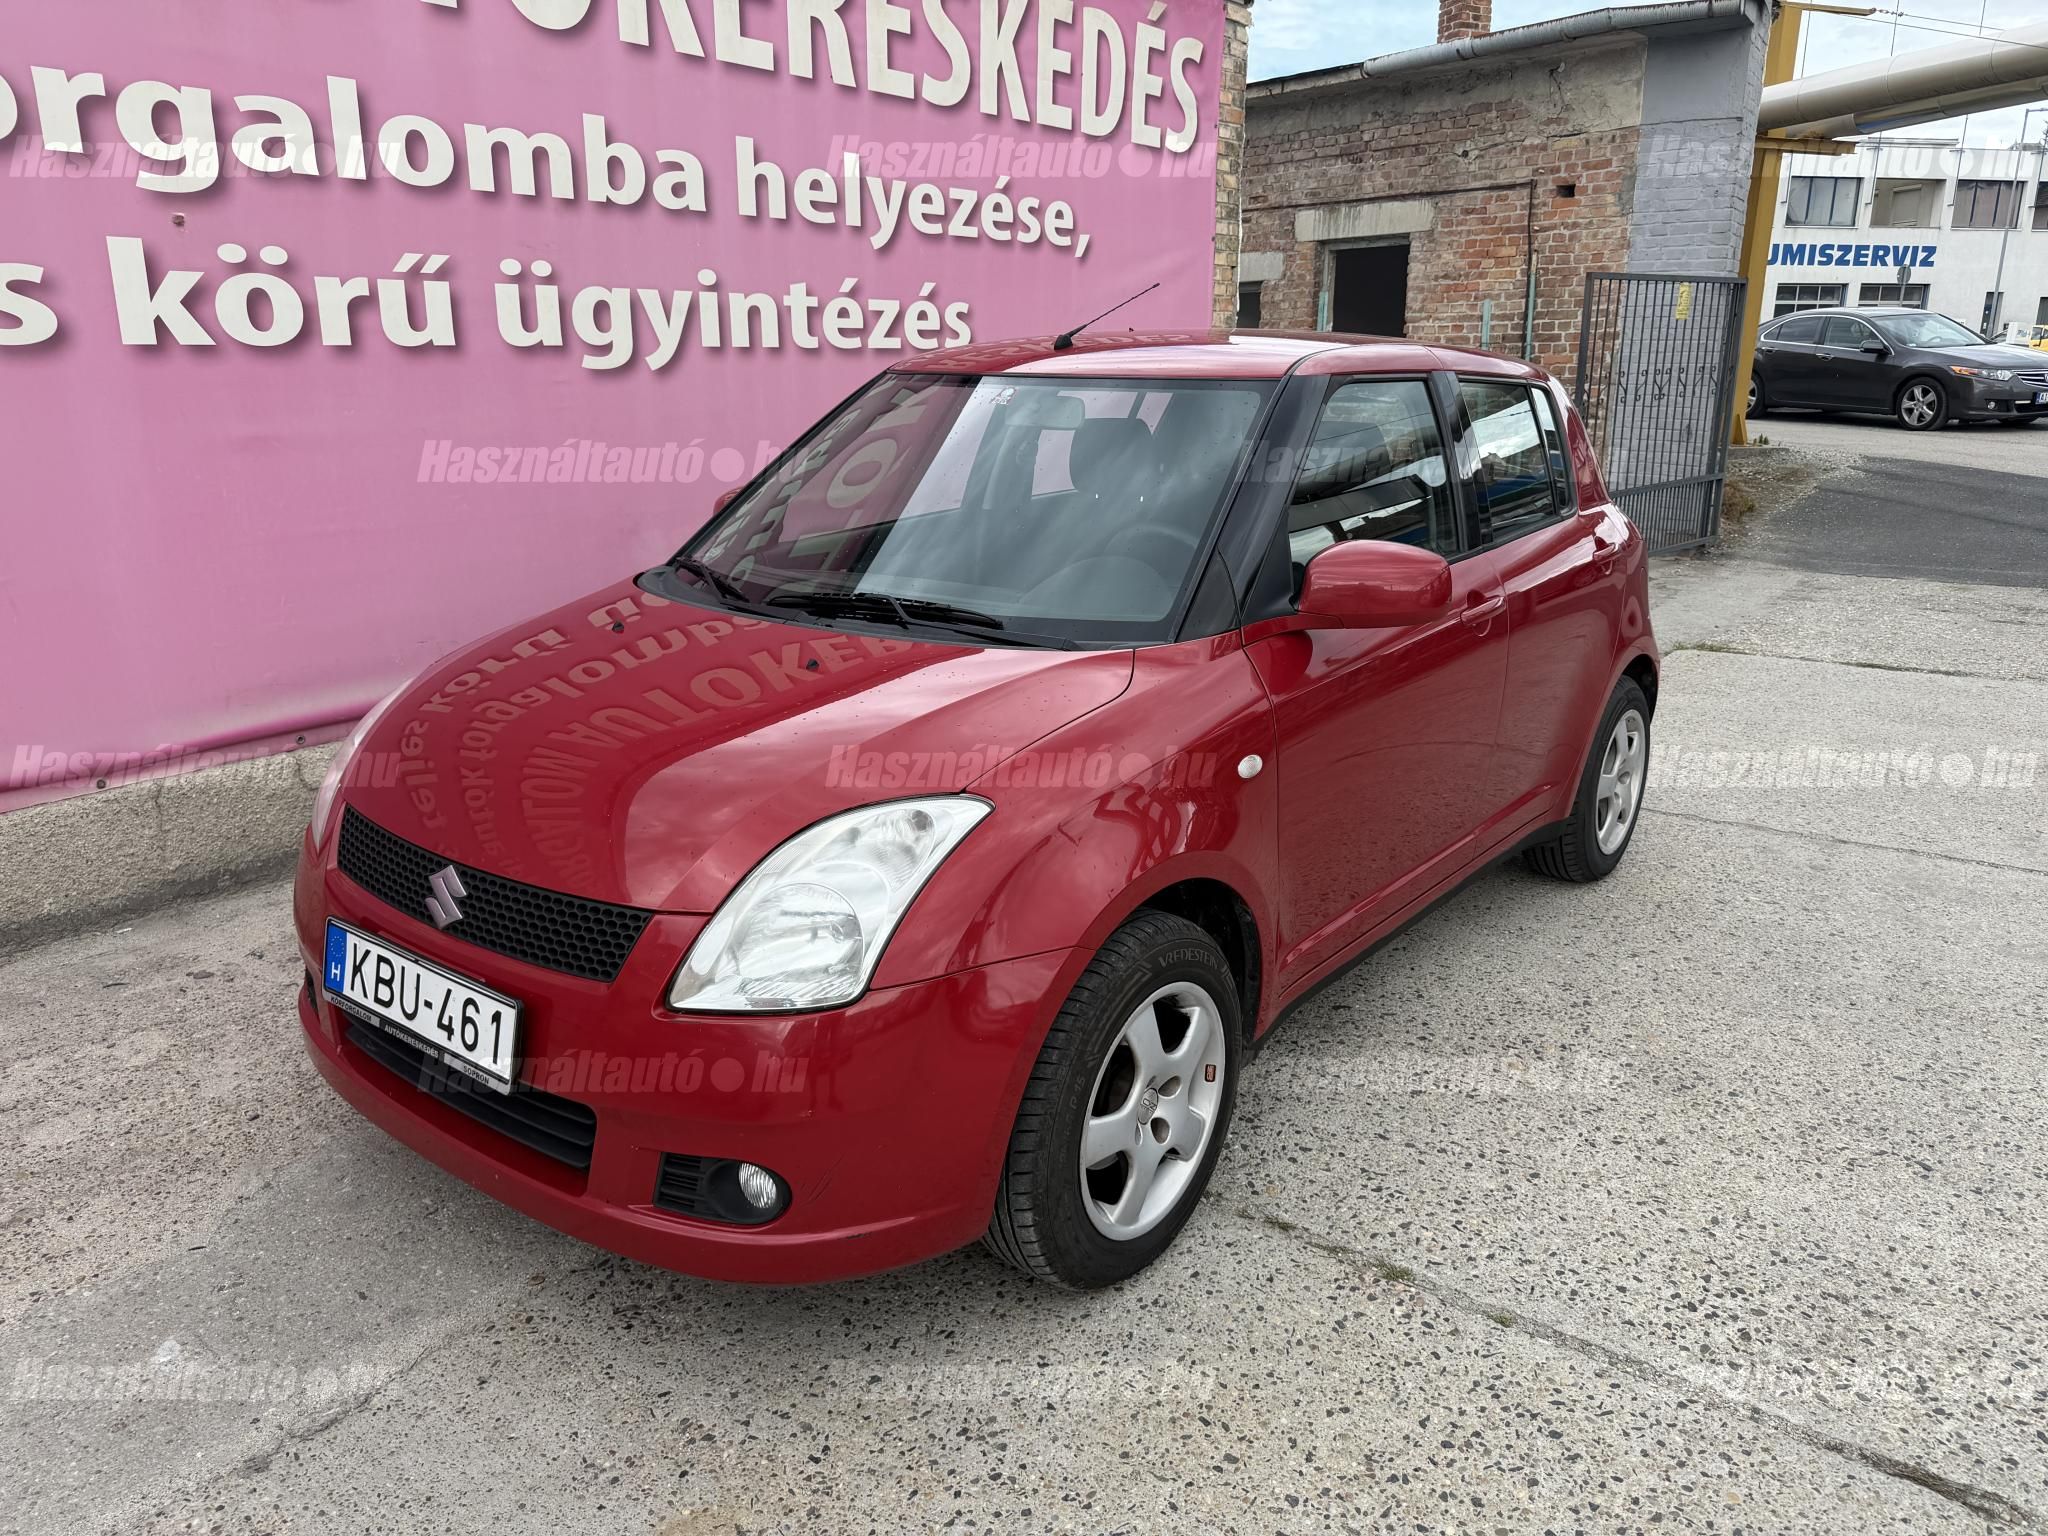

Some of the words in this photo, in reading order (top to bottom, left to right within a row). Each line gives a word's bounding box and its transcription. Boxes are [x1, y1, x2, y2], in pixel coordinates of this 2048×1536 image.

[0, 65, 706, 212] rgalomba
[735, 136, 1091, 258] helyezése,
[105, 235, 456, 347] körű
[494, 258, 972, 371] ügyintézés
[331, 962, 341, 982] H
[350, 942, 502, 1065] KBU-461
[1159, 948, 1218, 969] VREDESTEIN
[463, 1065, 490, 1085] SOPRON
